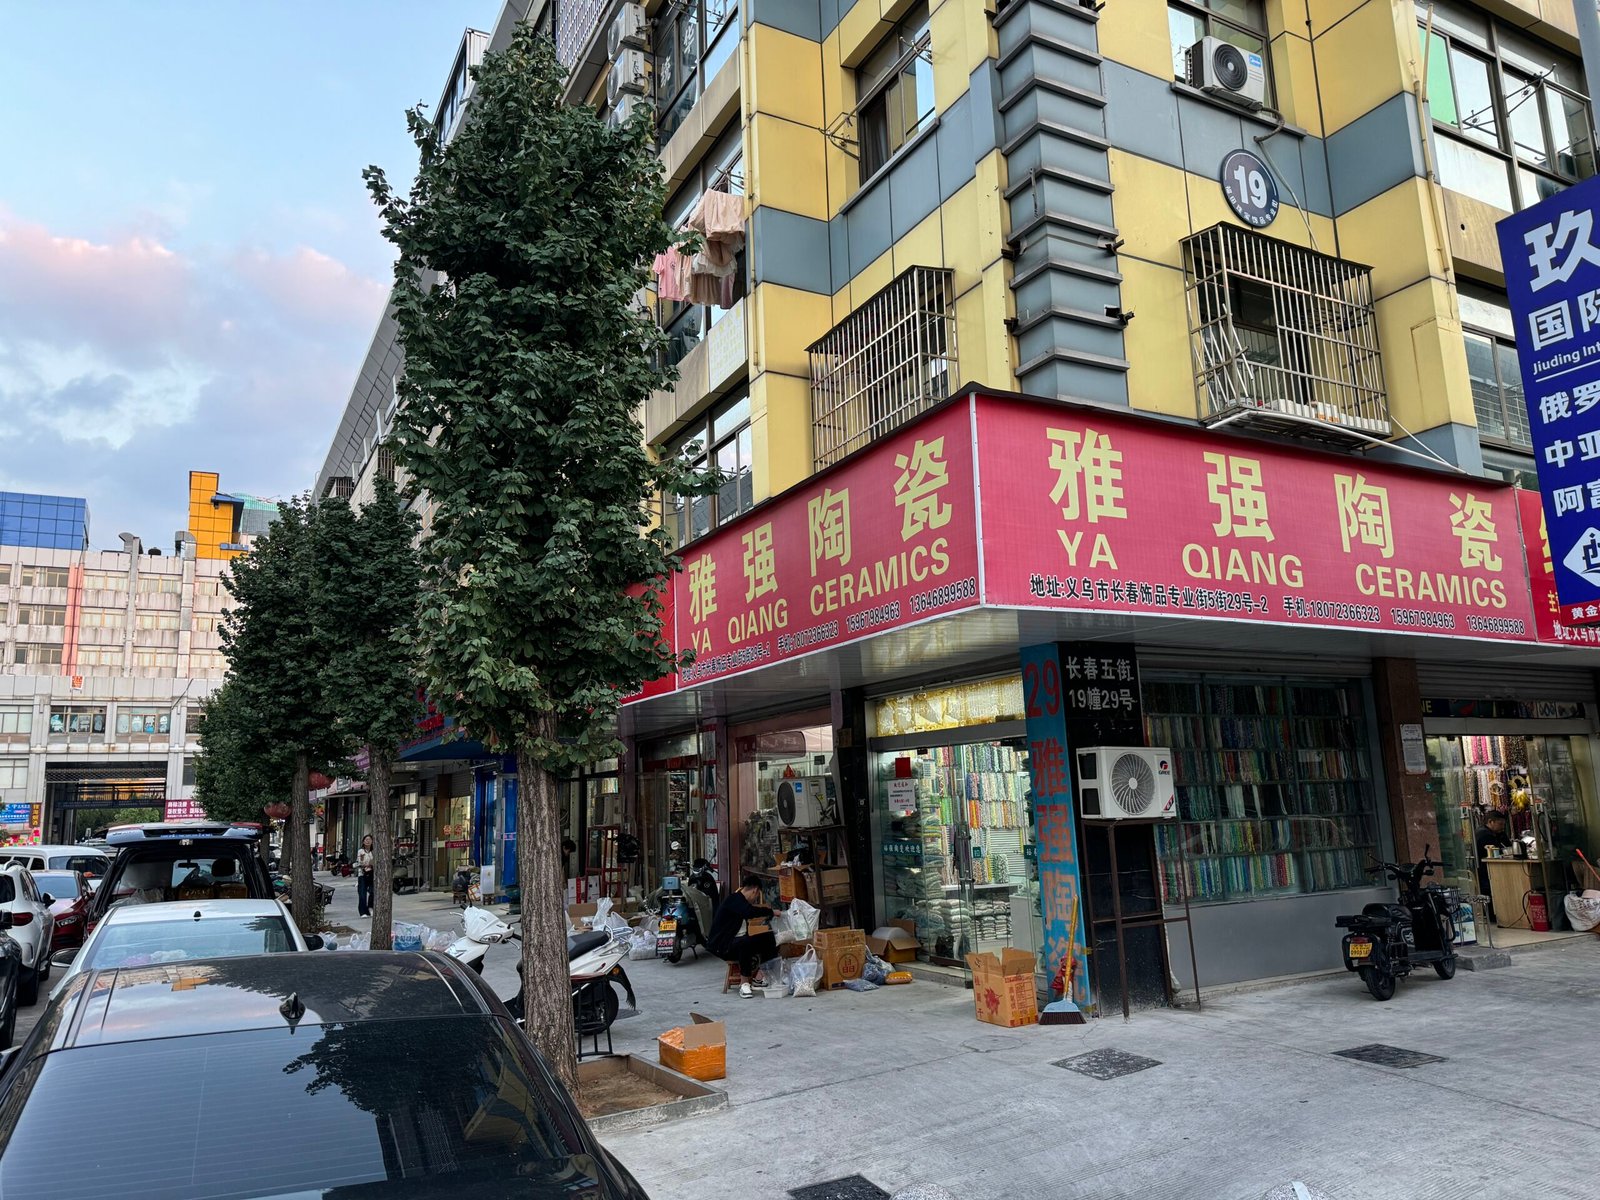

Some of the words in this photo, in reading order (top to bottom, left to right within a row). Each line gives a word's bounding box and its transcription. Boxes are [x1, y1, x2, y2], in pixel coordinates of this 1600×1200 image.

[1233, 164, 1268, 209] 19
[1523, 209, 1600, 294] 玖
[1533, 350, 1581, 376] Jiuding
[1046, 427, 1503, 572] 雅强陶瓷
[688, 436, 953, 625] 雅强陶瓷
[691, 630, 712, 654] YA
[727, 598, 788, 644] QIANG
[810, 538, 950, 616] CERAMICS
[1056, 530, 1119, 570] YA
[1182, 543, 1304, 588] QIANG
[1355, 563, 1508, 609] CERAMICS
[846, 601, 900, 634] 15967984963
[909, 577, 976, 615] 13646899588
[1029, 573, 1269, 614] 地址:义乌市长春饰品专业街5街29号-2
[1282, 595, 1381, 624] 手机:18072366323
[1391, 608, 1456, 630] 15967984963
[1466, 615, 1526, 636] 13646899588
[1024, 659, 1062, 718] 29
[1066, 655, 1135, 682] 长春五街
[1068, 686, 1135, 711] 19幢29号
